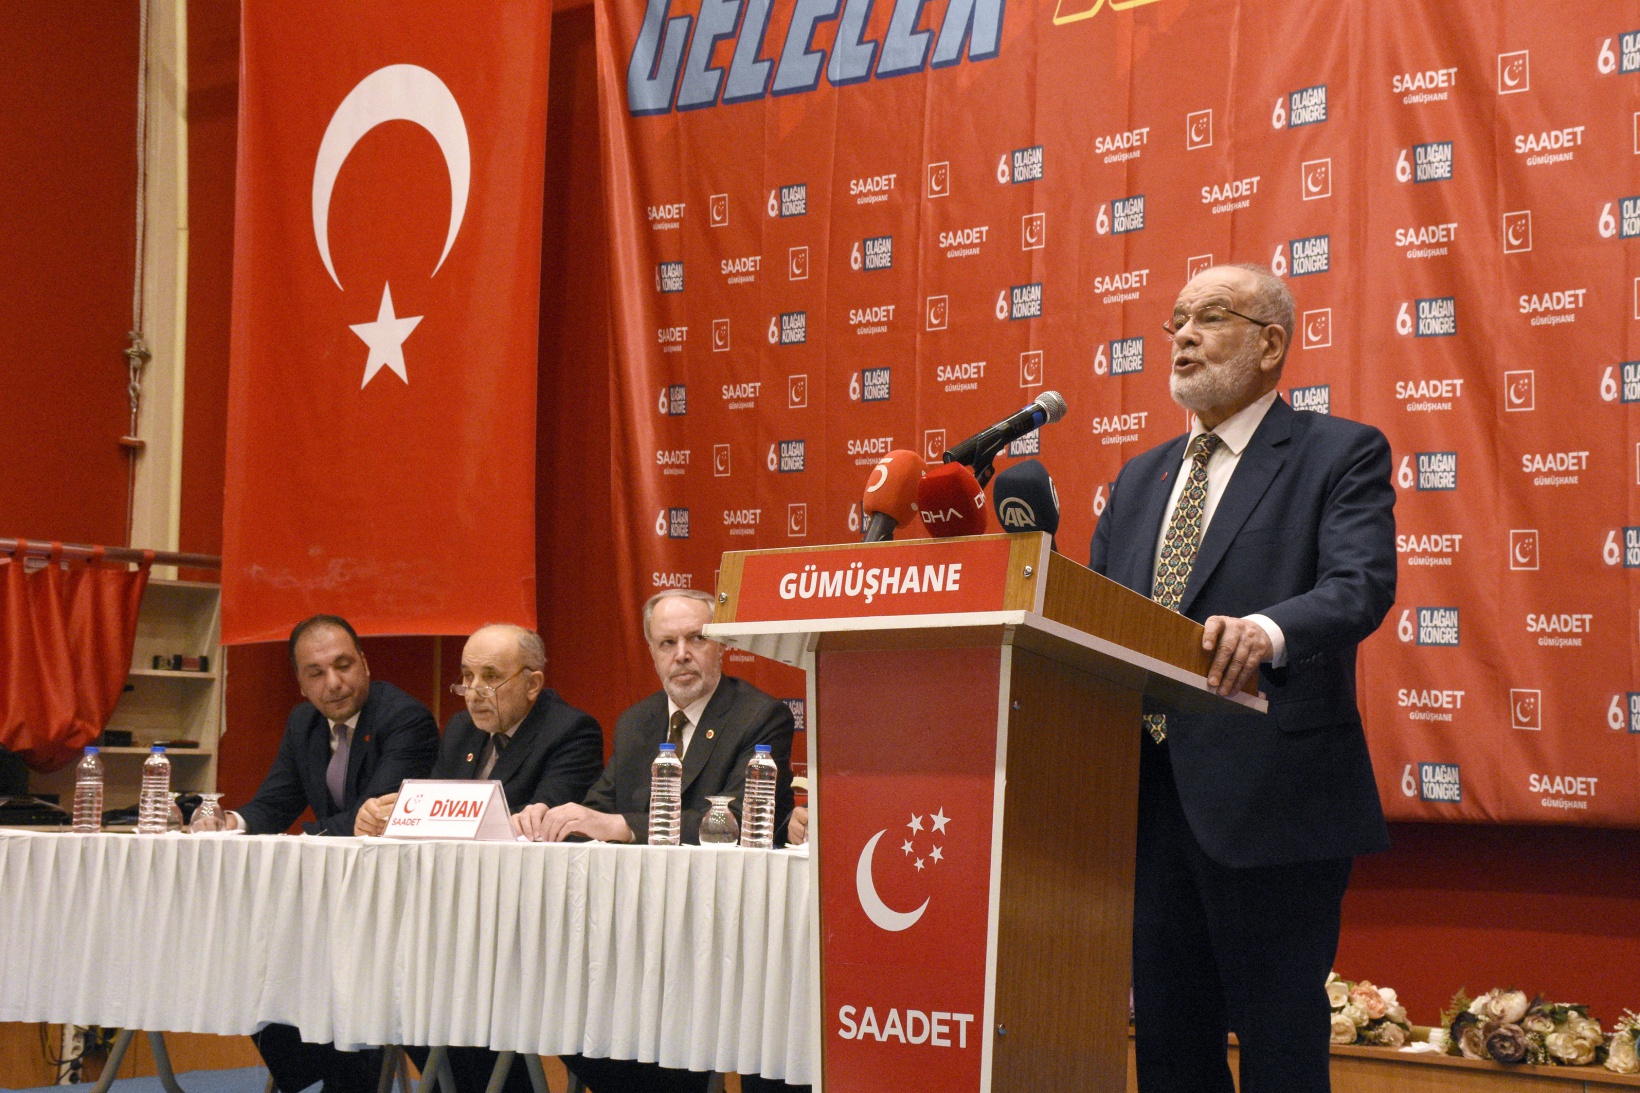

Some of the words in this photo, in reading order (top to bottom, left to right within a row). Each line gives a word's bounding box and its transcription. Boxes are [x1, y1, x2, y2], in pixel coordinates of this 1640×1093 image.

[1393, 67, 1458, 93] SAADET
[1292, 87, 1326, 110] OLAĞAN
[1291, 105, 1326, 126] KONGRE
[1095, 127, 1149, 154] SAADET
[1515, 126, 1585, 154] SAADET
[1014, 147, 1042, 166] OLAĞAN
[1416, 143, 1452, 166] OLAĞAN
[1527, 152, 1574, 167] GÜMÜŞHANE
[1014, 164, 1042, 182] KONGRE
[1417, 161, 1452, 181] KONGRE
[850, 173, 896, 195] SAADET
[1201, 176, 1260, 204] SAADET
[782, 185, 806, 203] OLAĞAN
[648, 203, 685, 221] SAADET
[782, 201, 806, 216] KONGRE
[1114, 197, 1144, 217] OLAĞAN
[1114, 214, 1144, 233] KONGRE
[939, 226, 988, 248] SAADET
[1395, 223, 1458, 247] SAADET
[866, 237, 891, 255] OLAĞAN
[1293, 238, 1328, 259] OLAĞAN
[721, 256, 761, 275] SAADET
[866, 251, 891, 269] KONGRE
[1293, 254, 1328, 275] KONGRE
[1094, 270, 1149, 294] SAADET
[1013, 285, 1041, 303] OLAĞAN
[1519, 289, 1586, 314] SAADET
[849, 305, 895, 324] SAADET
[1012, 301, 1041, 318] KONGRE
[1419, 299, 1455, 319] OLAĞAN
[782, 313, 806, 330] OLAĞAN
[1419, 316, 1456, 335] KONGRE
[782, 327, 806, 343] KONGRE
[1112, 340, 1143, 358] OLAĞAN
[937, 362, 986, 382] SAADET
[1112, 355, 1143, 373] KONGRE
[864, 369, 890, 386] OLAĞAN
[722, 382, 761, 400] SAADET
[864, 383, 890, 399] KONGRE
[1293, 386, 1329, 407] OLAĞAN
[1396, 379, 1464, 399] SAADET
[1092, 412, 1148, 434] SAADET
[780, 442, 804, 458] OLAĞAN
[847, 437, 893, 455] SAADET
[1010, 438, 1039, 456] KONGRE
[656, 450, 691, 465] SAADET
[780, 455, 804, 471] KONGRE
[1419, 453, 1456, 472] OLAĞAN
[1522, 451, 1589, 472] SAADET
[1419, 470, 1456, 489] KONGRE
[1093, 486, 1106, 516] 6
[723, 509, 761, 525] SAADET
[921, 508, 963, 524] DHA
[1397, 534, 1462, 553] SAADET
[652, 571, 692, 588] SAADET
[779, 562, 962, 604] GÜMÜŞHANE
[1420, 608, 1458, 627] OLAĞAN
[1526, 614, 1593, 633] SAADET
[1420, 627, 1458, 644] KONGRE
[1398, 688, 1465, 709] SAADET
[1422, 764, 1459, 784] OLAĞAN
[1423, 782, 1460, 801] KONGRE
[1529, 773, 1598, 796] SAADET
[392, 818, 421, 826] SAADET
[838, 1004, 974, 1049] SAADET
